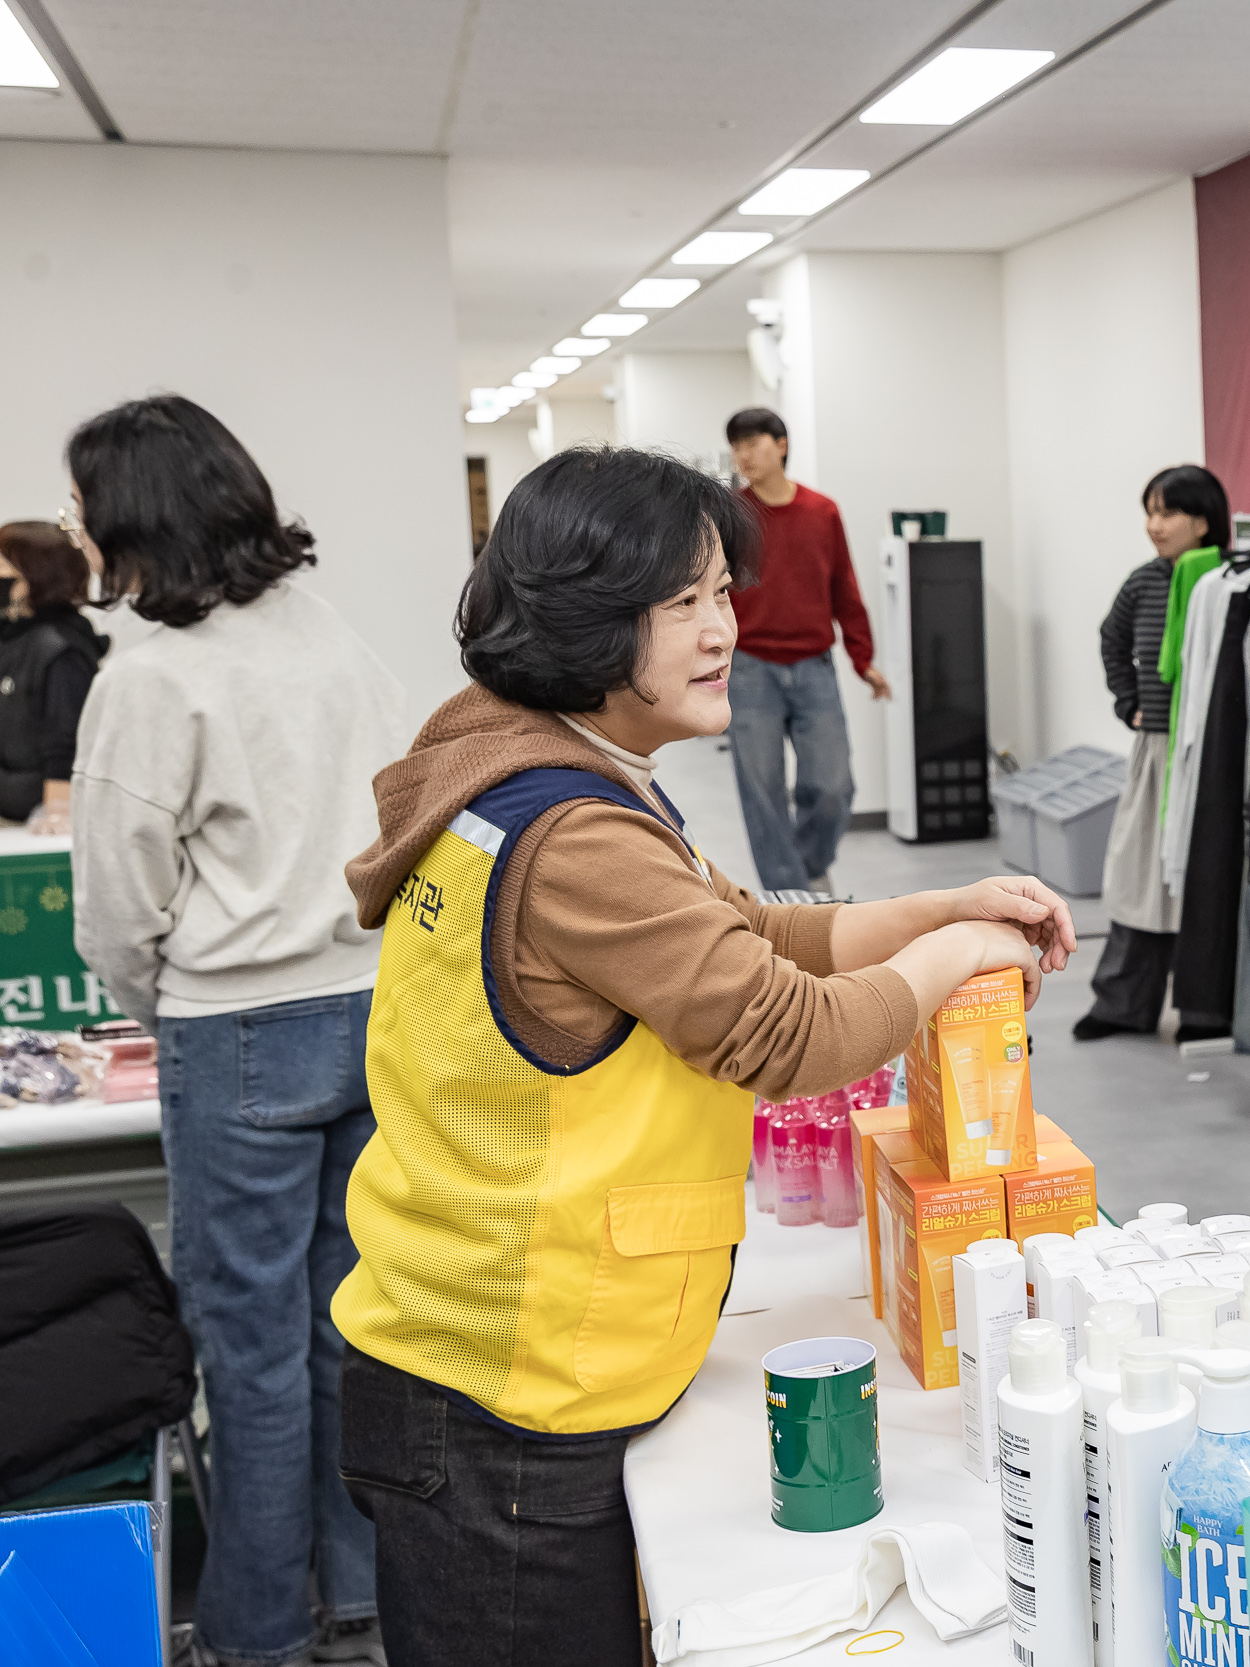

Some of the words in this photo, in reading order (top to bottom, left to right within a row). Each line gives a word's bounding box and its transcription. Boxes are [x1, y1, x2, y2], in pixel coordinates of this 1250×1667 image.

[941, 1005, 987, 1023] 리얼슈가
[988, 1000, 1020, 1017] 스크럽
[1014, 1189, 1053, 1206] 간편하게
[1014, 1200, 1060, 1218] 리얼슈가
[1060, 1194, 1092, 1211] 스크럽
[922, 1202, 961, 1219] 간편하게
[922, 1213, 967, 1231] 리얼슈가
[968, 1208, 1000, 1225] 스크럽
[766, 1389, 787, 1408] COIN
[1193, 1515, 1223, 1529] HAPPY
[1197, 1525, 1221, 1537] BATH
[1175, 1530, 1250, 1627] ICE
[1178, 1611, 1250, 1667] MINT
